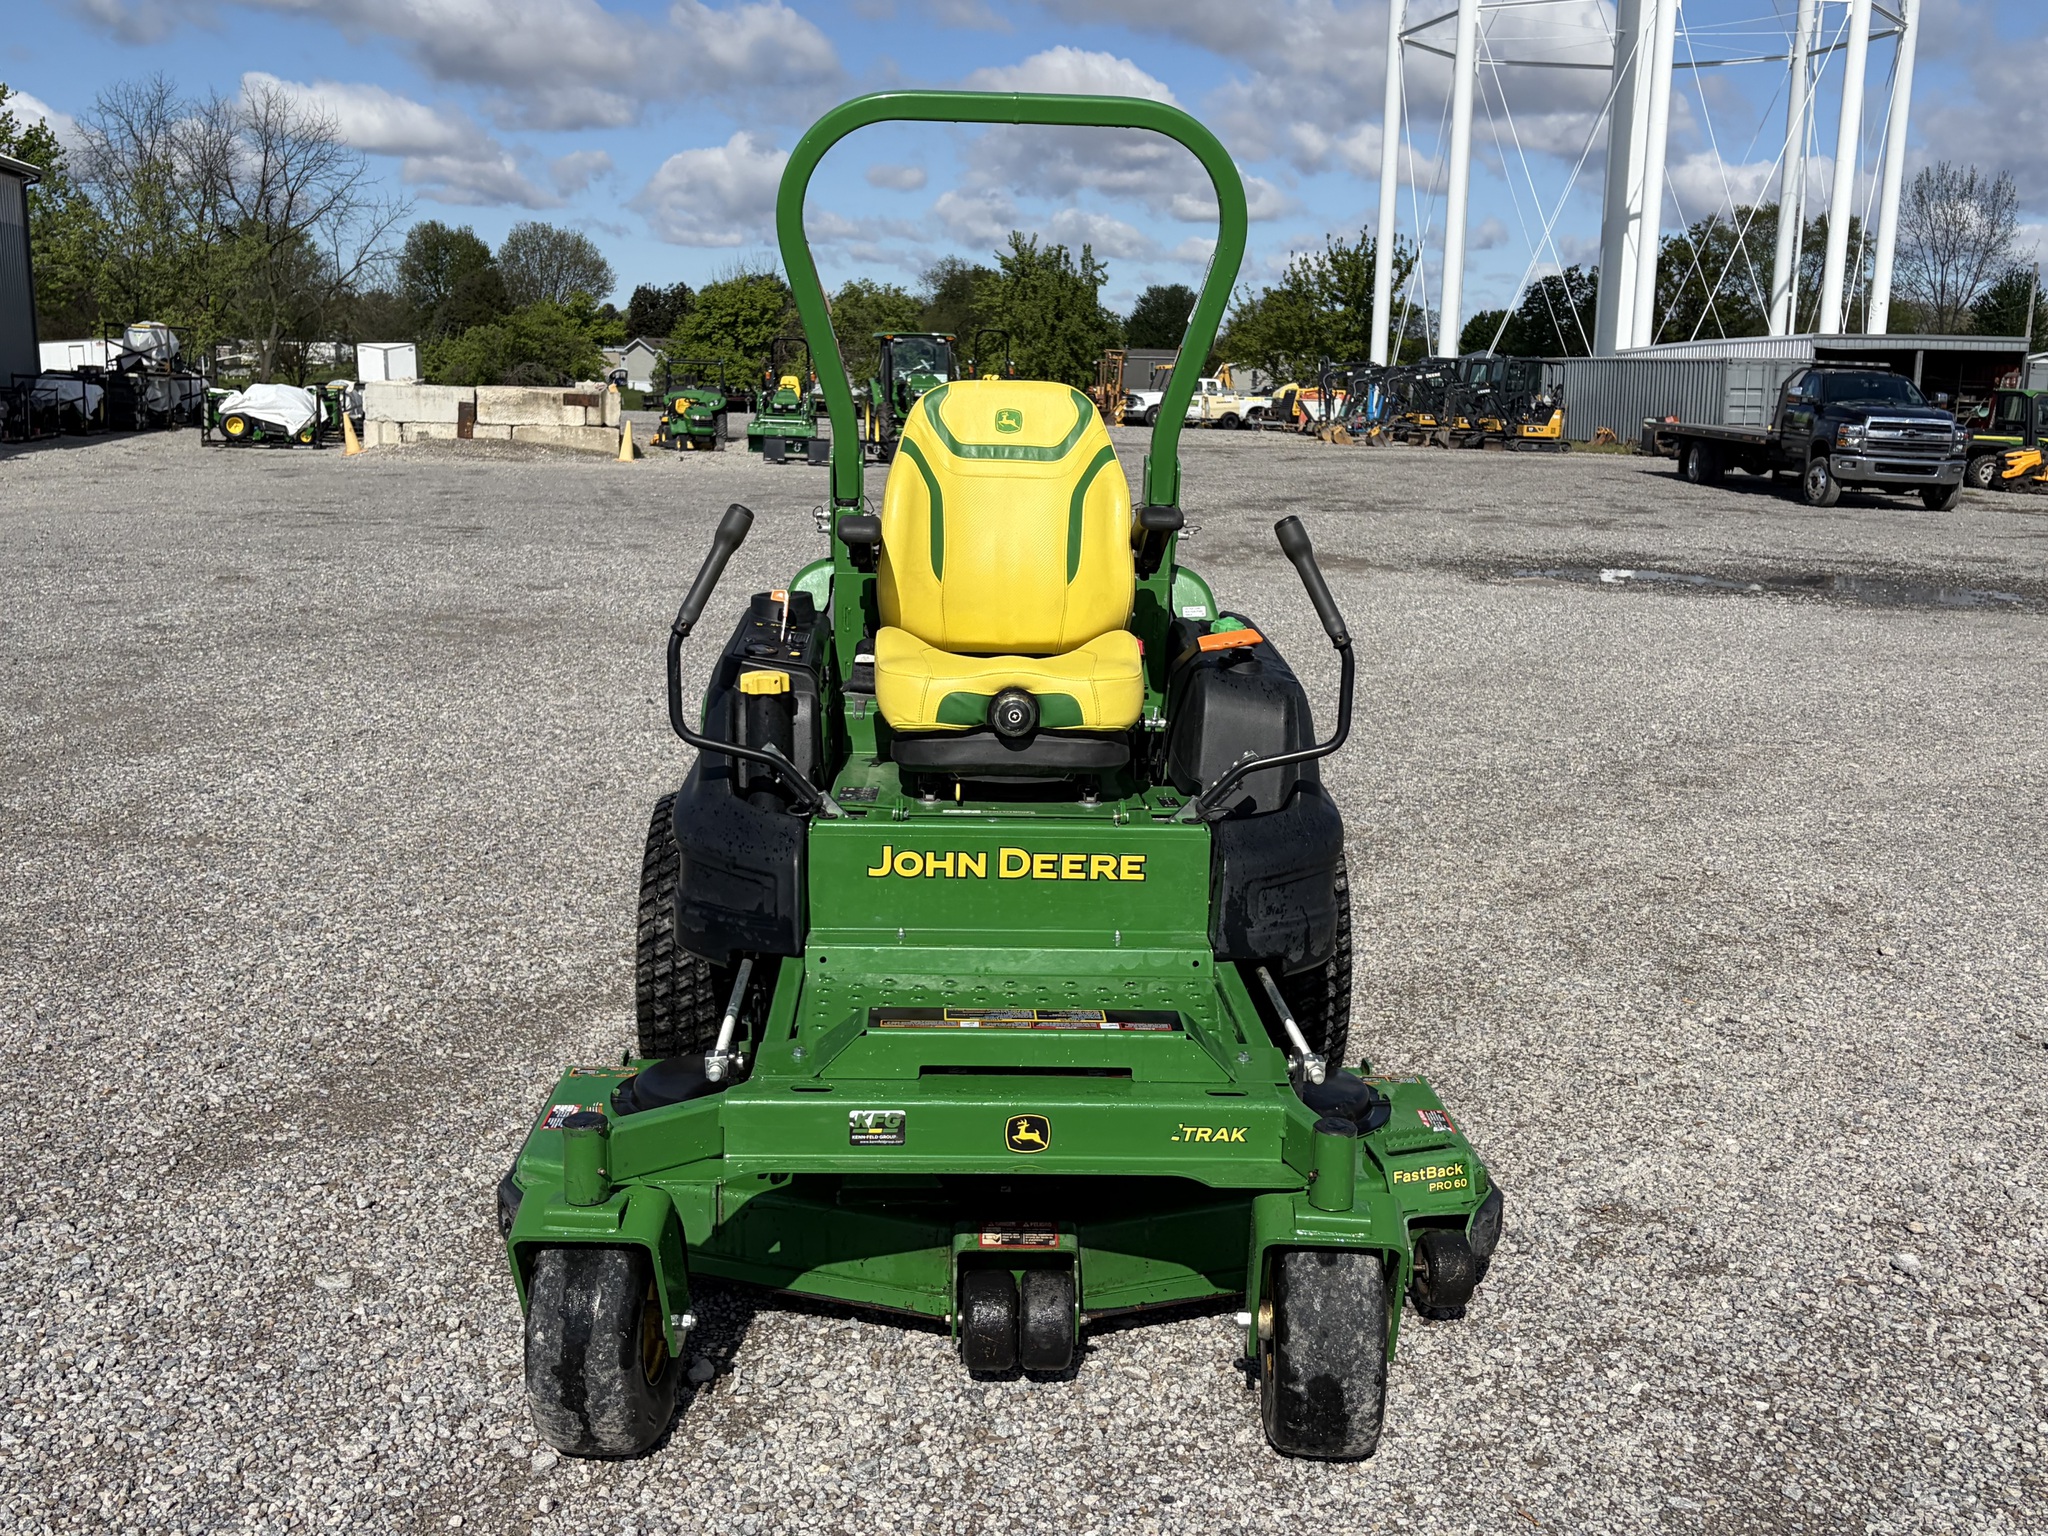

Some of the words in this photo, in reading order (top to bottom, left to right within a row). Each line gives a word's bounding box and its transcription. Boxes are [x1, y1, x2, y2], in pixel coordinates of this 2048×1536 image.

[867, 845, 988, 879] JOHN
[998, 847, 1147, 881] DEERE
[854, 1112, 902, 1128] KFG
[1170, 1123, 1249, 1142] TRAK
[1393, 1162, 1464, 1184] FastBack
[1428, 1180, 1453, 1192] PRO
[1453, 1178, 1468, 1189] 60
